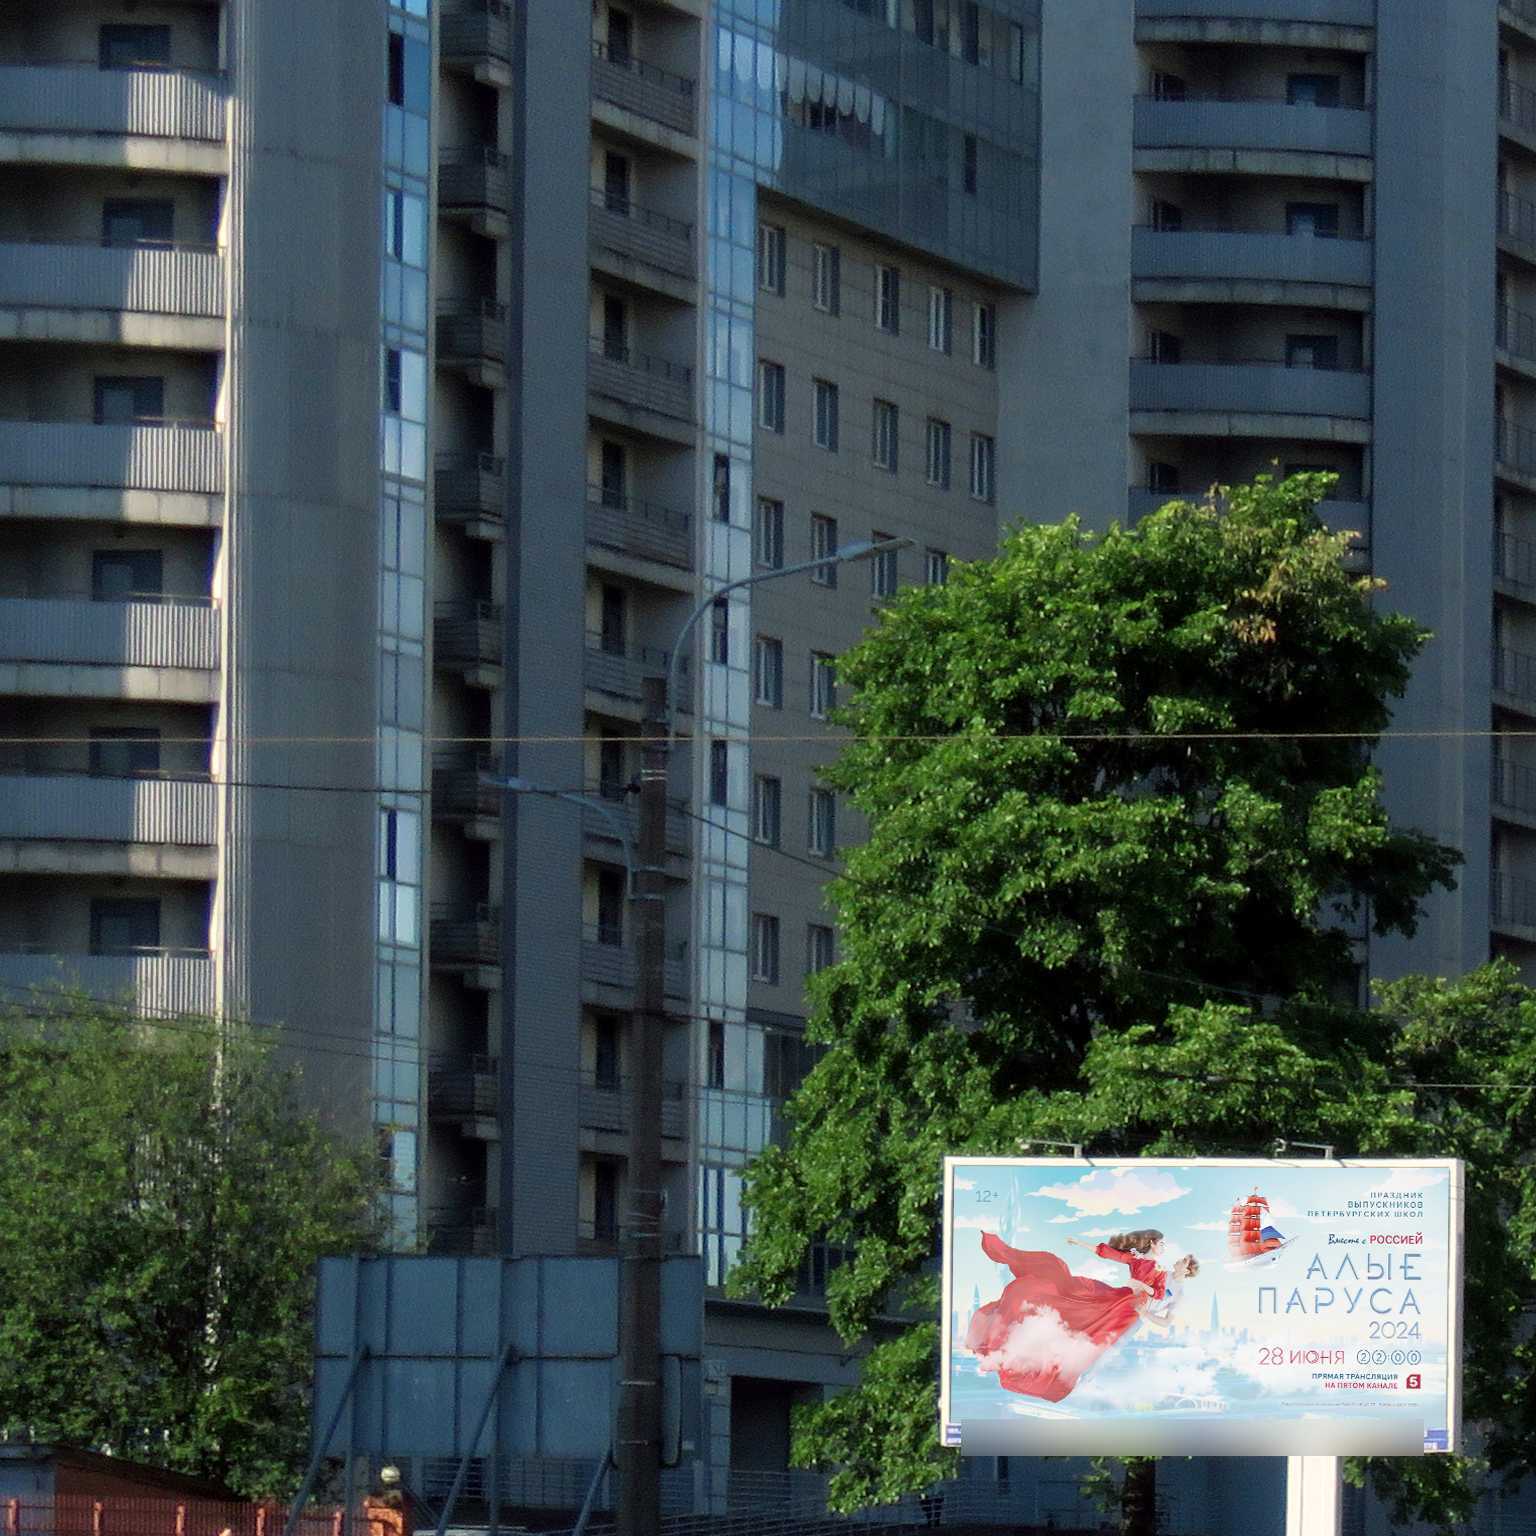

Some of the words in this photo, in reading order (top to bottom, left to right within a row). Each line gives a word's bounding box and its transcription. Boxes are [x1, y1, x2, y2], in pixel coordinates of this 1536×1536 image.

[975, 1190, 1001, 1203] 12+
[1370, 1191, 1424, 1199] ПРАЗДНИК
[1347, 1201, 1424, 1209] ВЫПУСКНИКОВ
[1307, 1210, 1390, 1218] ПЕТЕРБУРГСКИХ
[1394, 1210, 1424, 1218] ШКОЛ
[1369, 1232, 1423, 1245] РОССИЕЙ
[1306, 1253, 1422, 1281] АЛЫЕ
[1258, 1287, 1421, 1314] ПАРУСА
[1369, 1321, 1420, 1339] 2024
[1258, 1347, 1284, 1366] 28
[1289, 1350, 1345, 1365] ИЮНЯ
[1345, 1373, 1398, 1381] ТРАНСЛЯЦИЯ
